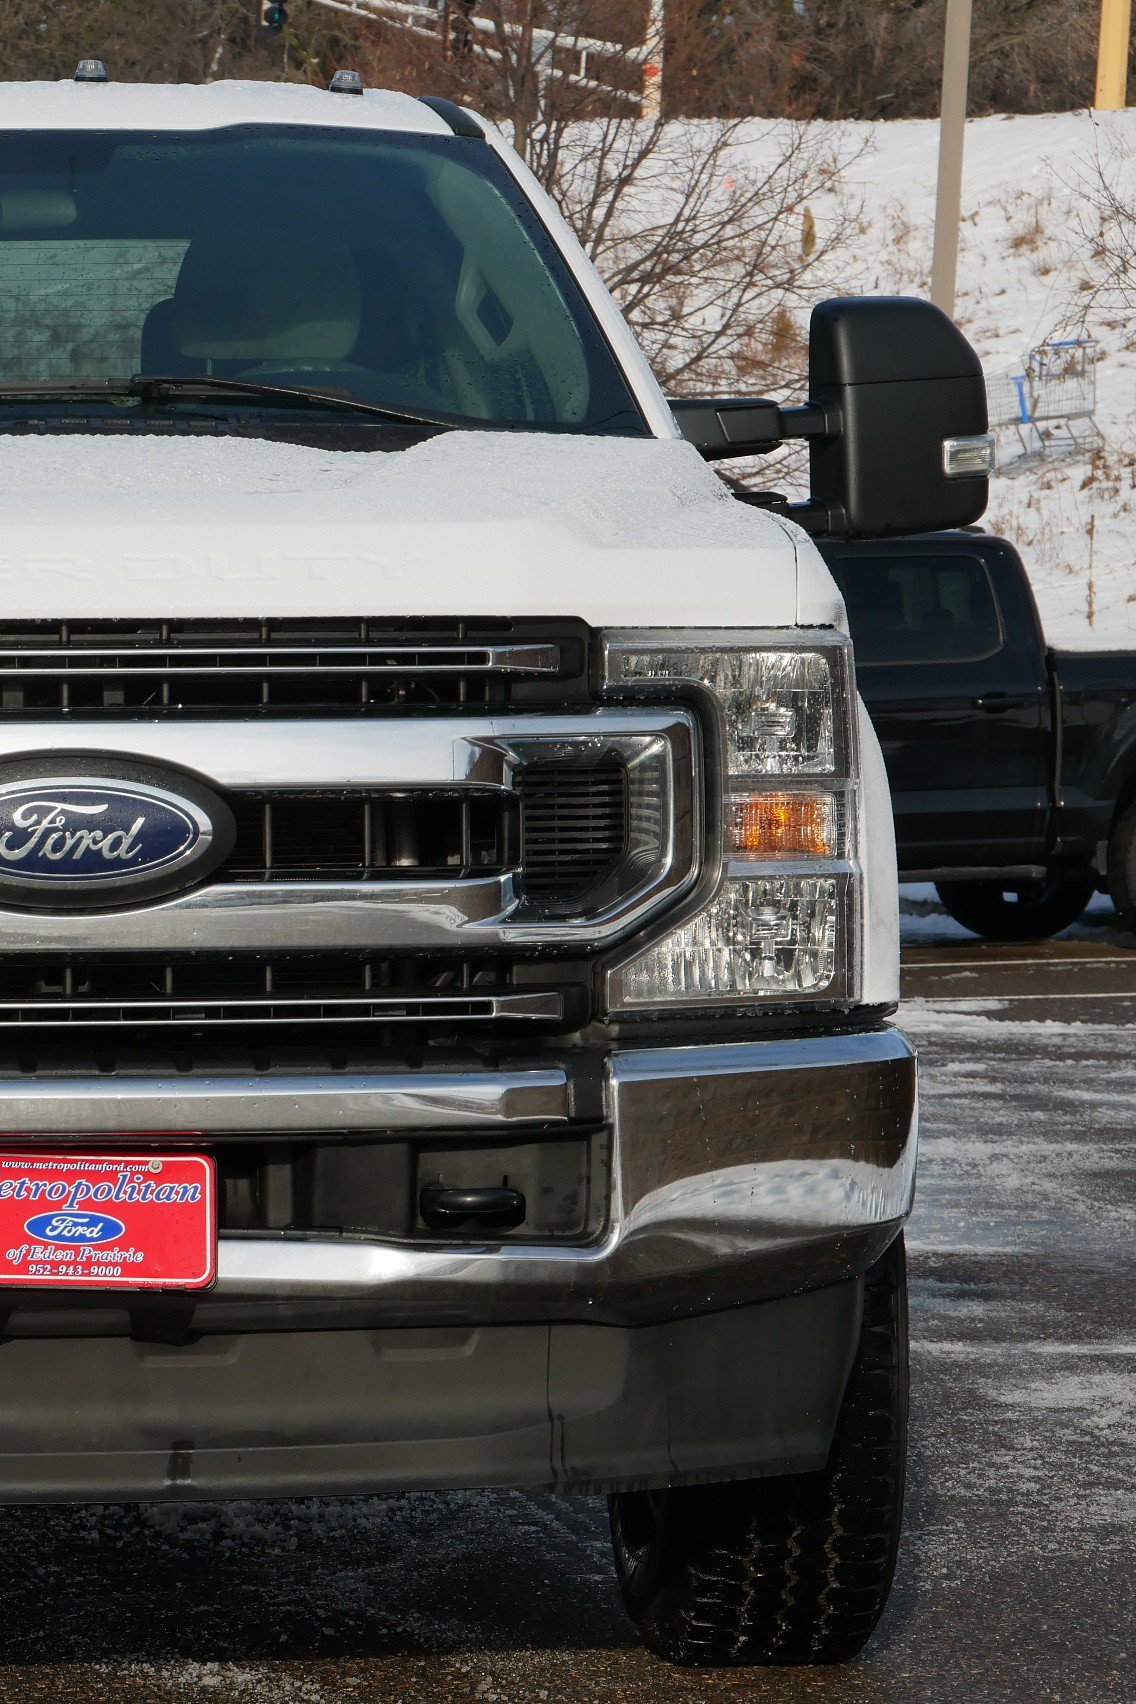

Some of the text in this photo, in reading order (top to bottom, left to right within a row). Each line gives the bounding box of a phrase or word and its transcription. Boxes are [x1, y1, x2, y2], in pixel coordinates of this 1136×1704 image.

[122, 552, 424, 583] DUTY
[1, 1159, 149, 1173] www.metropolitanford.com
[45, 1216, 103, 1239] Ford
[6, 1245, 144, 1265] of Eden Prairie
[27, 1264, 122, 1277] 952-943-9000
